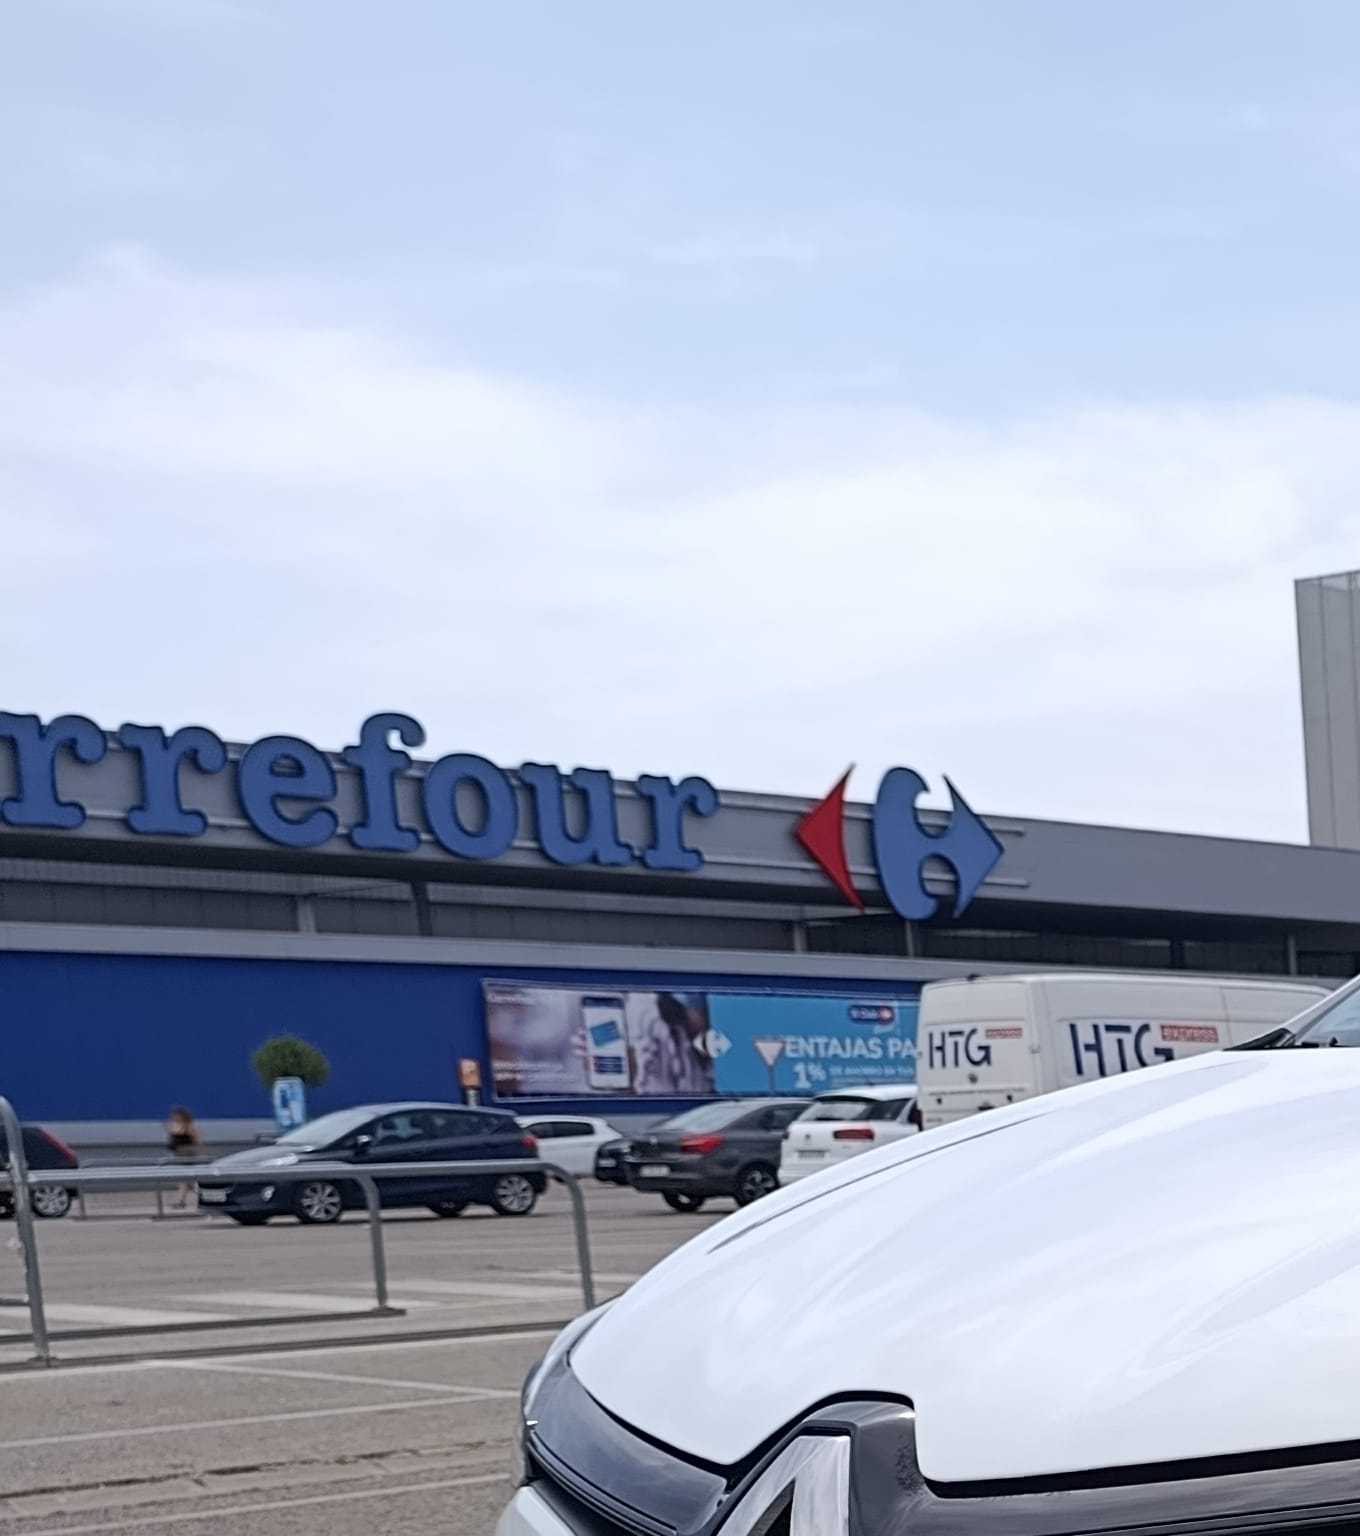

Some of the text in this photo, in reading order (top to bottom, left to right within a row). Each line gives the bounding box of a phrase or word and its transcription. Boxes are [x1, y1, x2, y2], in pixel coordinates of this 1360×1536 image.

[0, 712, 720, 871] rrefour
[784, 1036, 884, 1059] ENTAJAS
[928, 1028, 992, 1069] HTG
[1069, 1023, 1175, 1077] HTG
